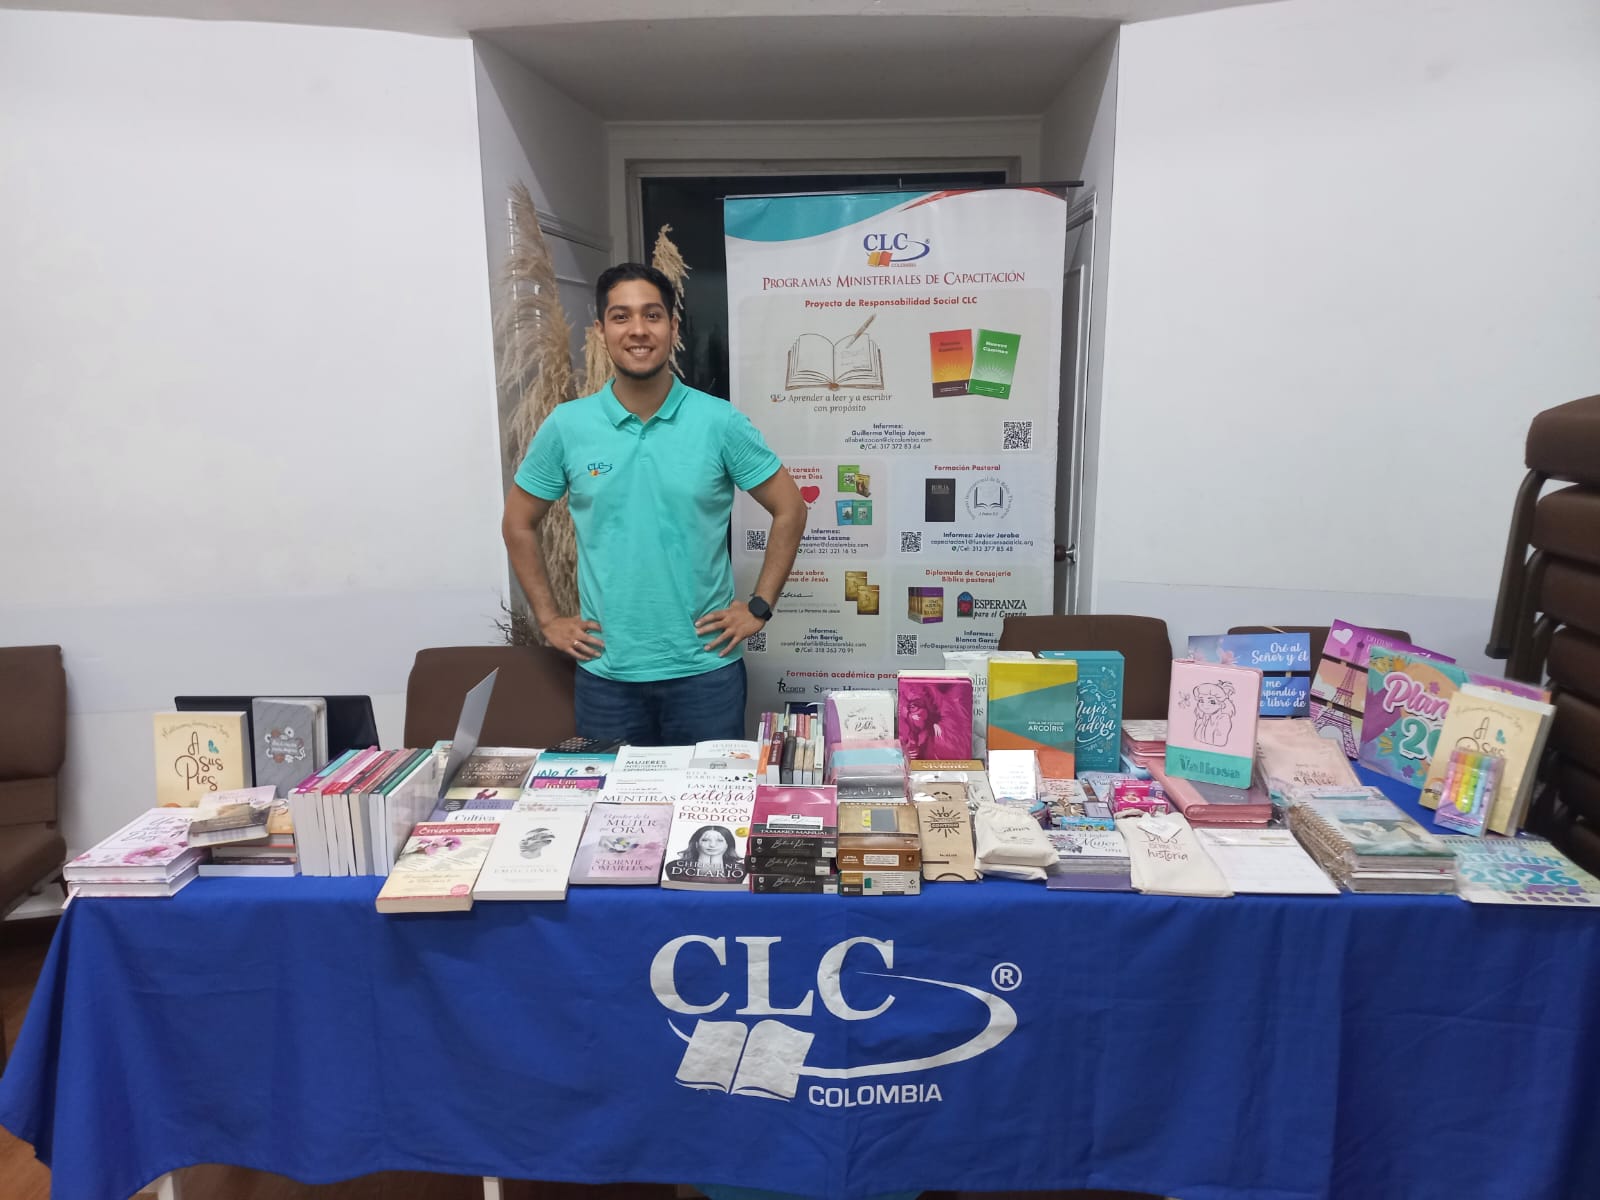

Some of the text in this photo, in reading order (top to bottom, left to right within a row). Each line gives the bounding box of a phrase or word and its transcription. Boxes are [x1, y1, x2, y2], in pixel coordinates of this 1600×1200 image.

[863, 232, 909, 251] CLC
[762, 270, 1025, 291] PROGRAMAS MINISTERIALES DE CAPACITACIÓN
[805, 296, 978, 309] Proyecto de Responsabilidad Social CLC
[999, 386, 1006, 394] 2
[788, 393, 823, 402] Aprender
[833, 393, 847, 401] leer
[848, 395, 854, 403] y
[863, 393, 893, 401] escribir
[829, 404, 867, 413] propósito
[934, 464, 970, 472] Formación
[925, 569, 963, 577] Diplomado
[974, 599, 1027, 609] ESPERANZA
[973, 611, 989, 620] para
[991, 610, 997, 618] el
[1251, 649, 1283, 665] Señor
[1286, 654, 1294, 666] y
[786, 670, 898, 681] Formación académica para
[1298, 690, 1306, 700] y
[1028, 724, 1064, 732] ARCOIRIS
[187, 731, 200, 755] A
[679, 789, 755, 802] exitosas
[607, 819, 657, 827] MUJER
[1147, 849, 1189, 861] historia
[671, 866, 744, 878] D'CLARIO
[1460, 868, 1580, 886] 2026
[649, 934, 897, 1021] CLC
[808, 1083, 943, 1109] COLOMBIA
